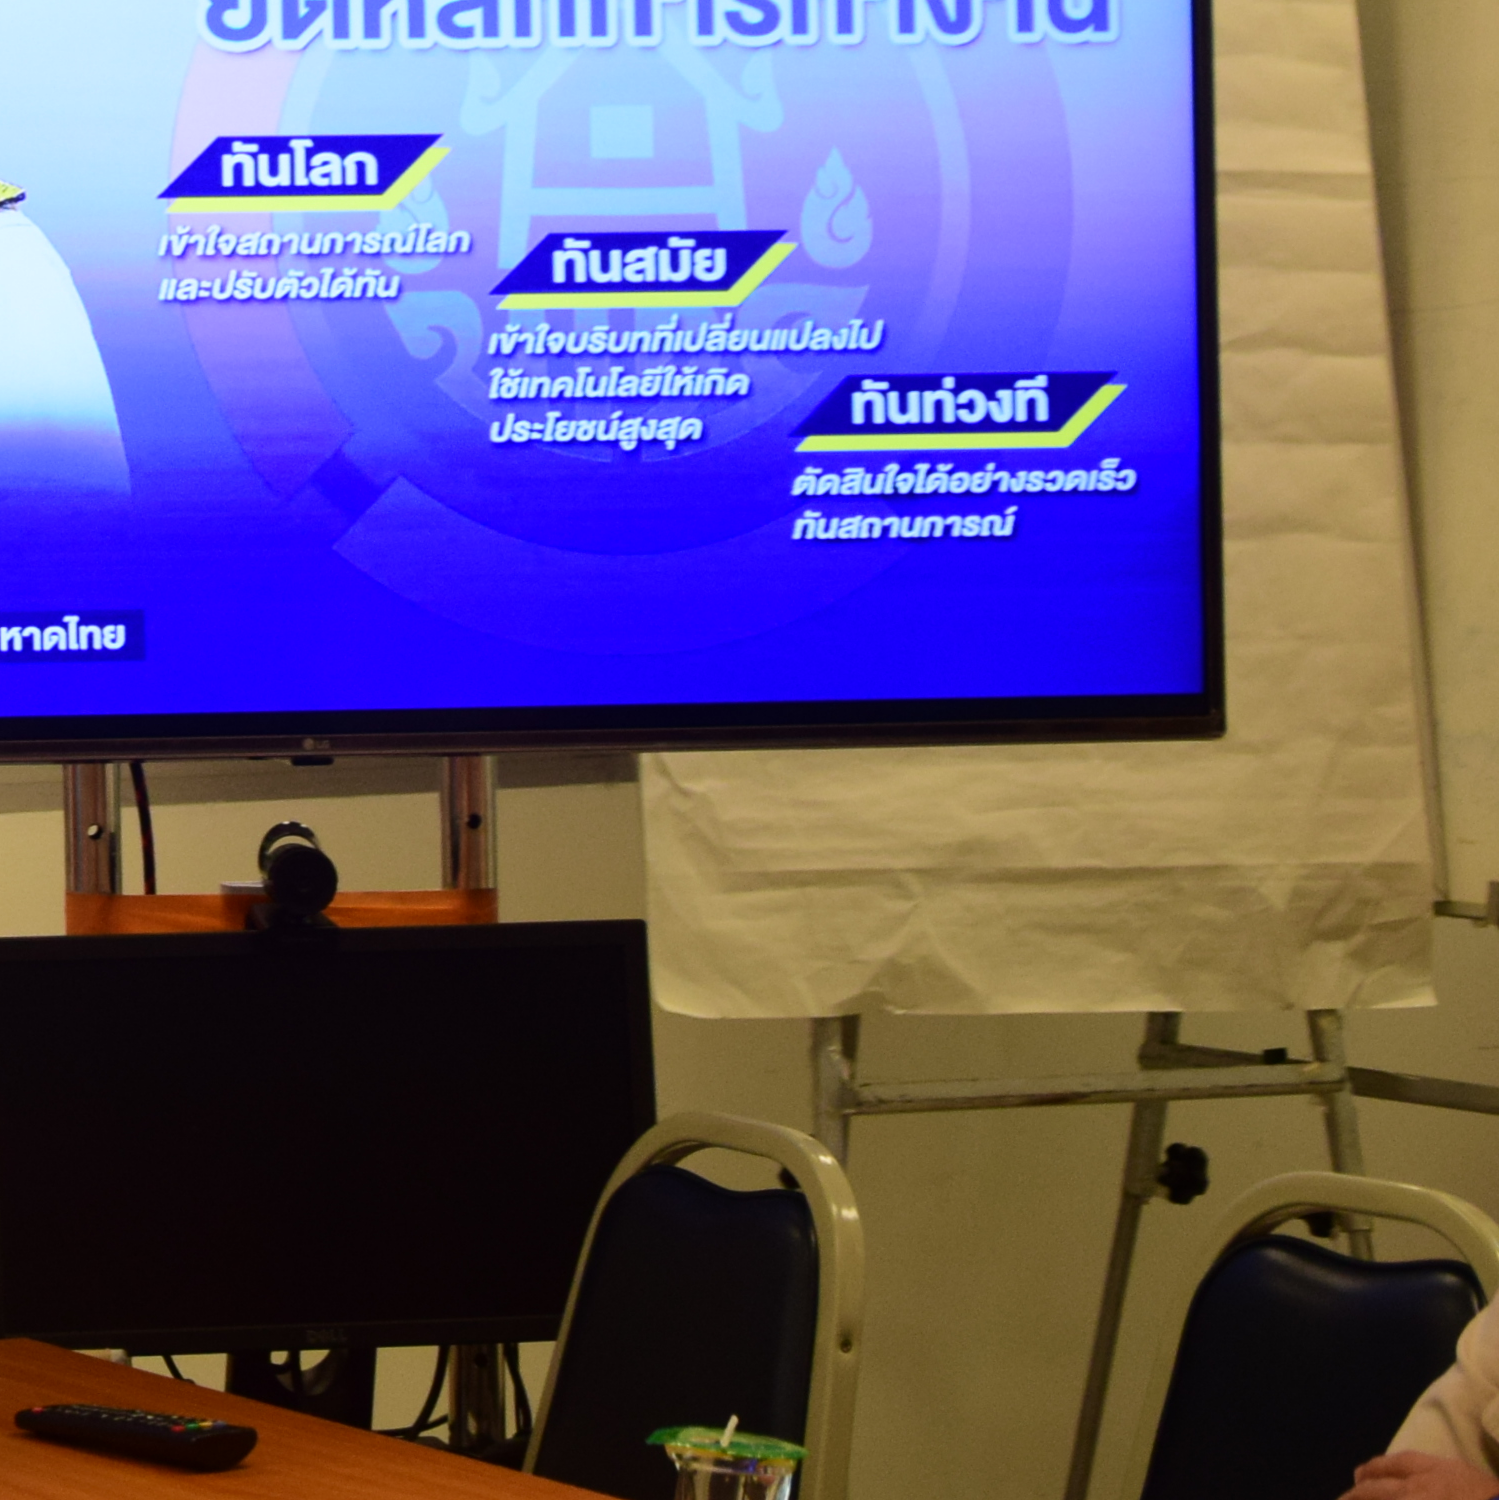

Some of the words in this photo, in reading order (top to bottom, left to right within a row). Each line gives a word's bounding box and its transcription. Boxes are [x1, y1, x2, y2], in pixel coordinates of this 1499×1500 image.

[221, 140, 381, 190] ทันโลก
[156, 224, 472, 262] เข้าใจสถานการณ์โลก
[550, 235, 729, 286] ทันสมัย
[156, 265, 400, 304] และปรับตัวได้ทัน
[486, 317, 884, 359] เข้าใจบริบทที่เปลี่ยนแปลงไป
[486, 364, 750, 404] ใช้เทคโนโลยีให้เกิด
[849, 379, 1051, 430] ทันท่วงที
[488, 410, 703, 456] ประโยชน์สูงสุด
[790, 458, 1138, 500] ตัดสินใจได้อย่างรวดเร็ว
[790, 502, 1015, 541] ทันสถานการณ์
